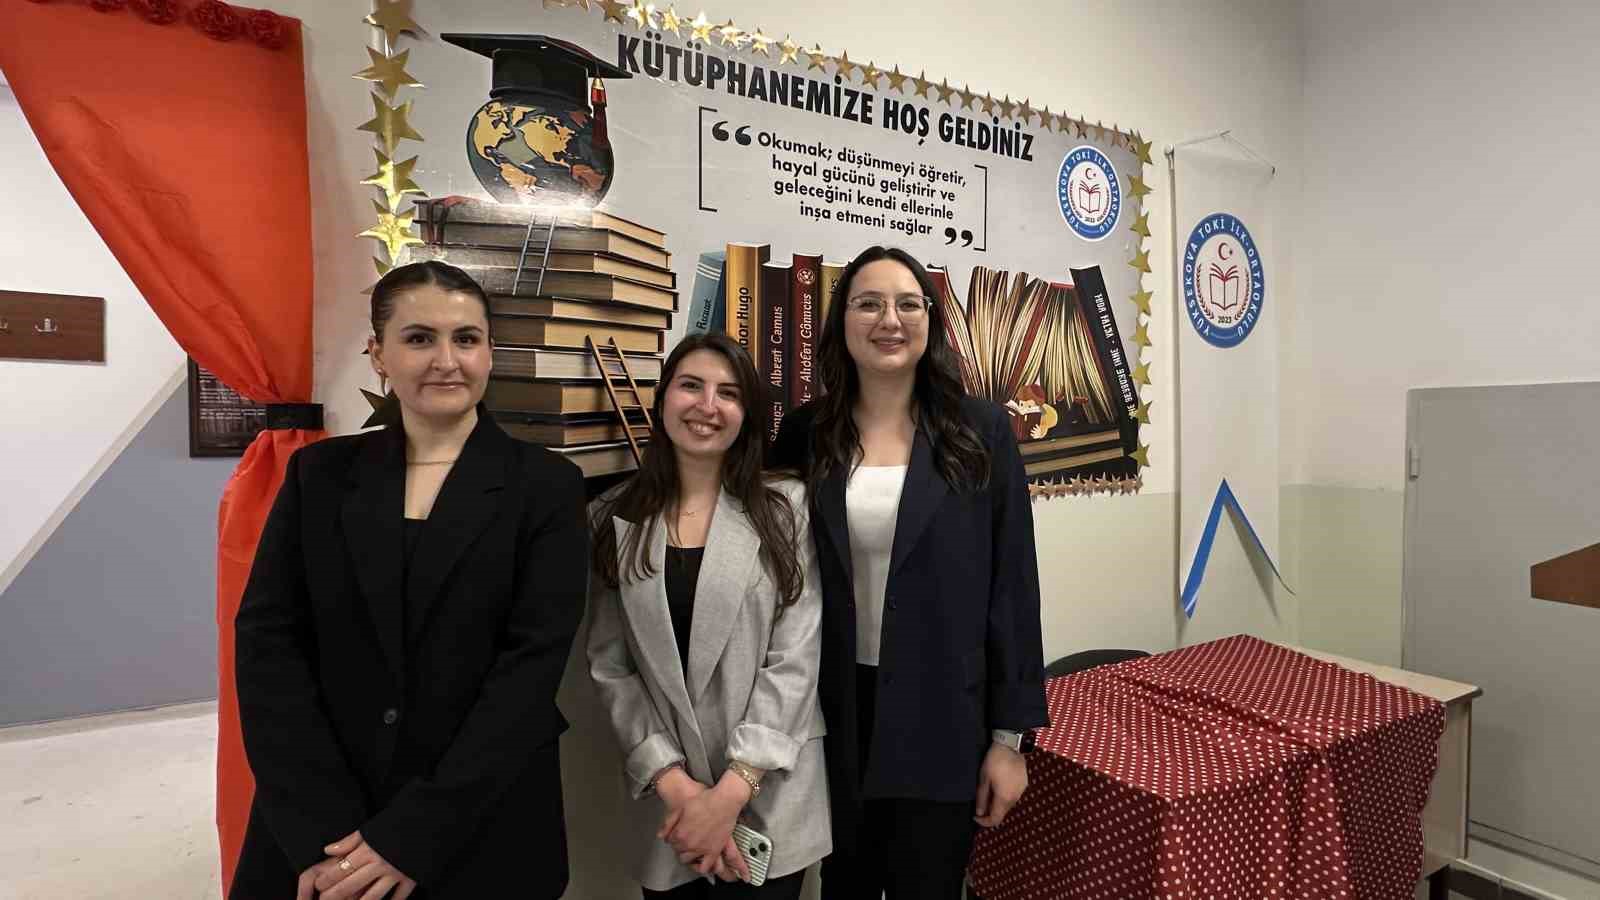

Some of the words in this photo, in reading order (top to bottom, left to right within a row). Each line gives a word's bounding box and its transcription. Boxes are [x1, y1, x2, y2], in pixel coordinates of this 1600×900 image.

[618, 31, 874, 125] KÜTÜPHANEMİZE
[883, 98, 930, 146] HOŞ
[938, 112, 1034, 162] GELDİNİZ
[757, 131, 833, 161] Okumak;
[838, 147, 915, 178] düşünmeyi
[919, 164, 966, 188] öğretir,
[772, 154, 817, 177] hayal
[823, 166, 876, 188] gücünü
[880, 177, 937, 198] geliştirir
[940, 190, 956, 202] ve
[774, 178, 853, 204] geleceğini
[857, 189, 896, 210] kendi
[901, 199, 954, 220] ellerinle
[800, 200, 831, 222] inşa
[836, 210, 885, 229] etmeni
[890, 218, 933, 236] sağlar
[1198, 217, 1225, 240] TOKİ
[736, 287, 752, 320] Hugo
[770, 305, 784, 344] Camus
